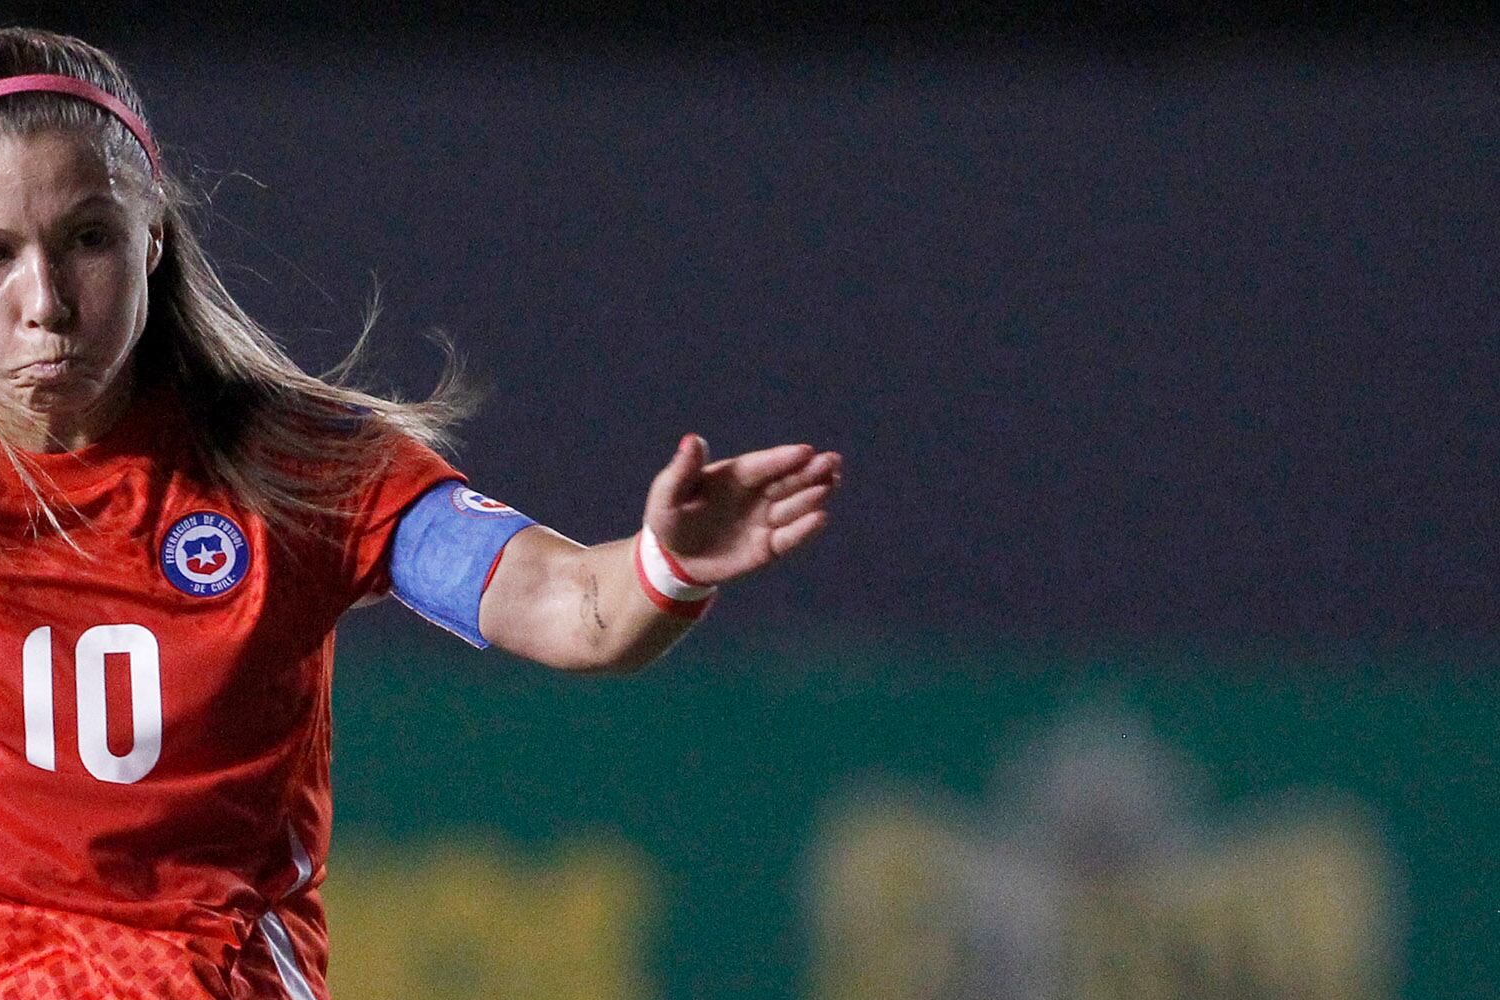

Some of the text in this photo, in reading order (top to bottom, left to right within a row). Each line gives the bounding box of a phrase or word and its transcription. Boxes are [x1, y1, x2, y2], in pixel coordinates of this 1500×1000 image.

[203, 514, 215, 526] DE
[218, 520, 244, 549] FUTBOL
[22, 623, 162, 785] 10
